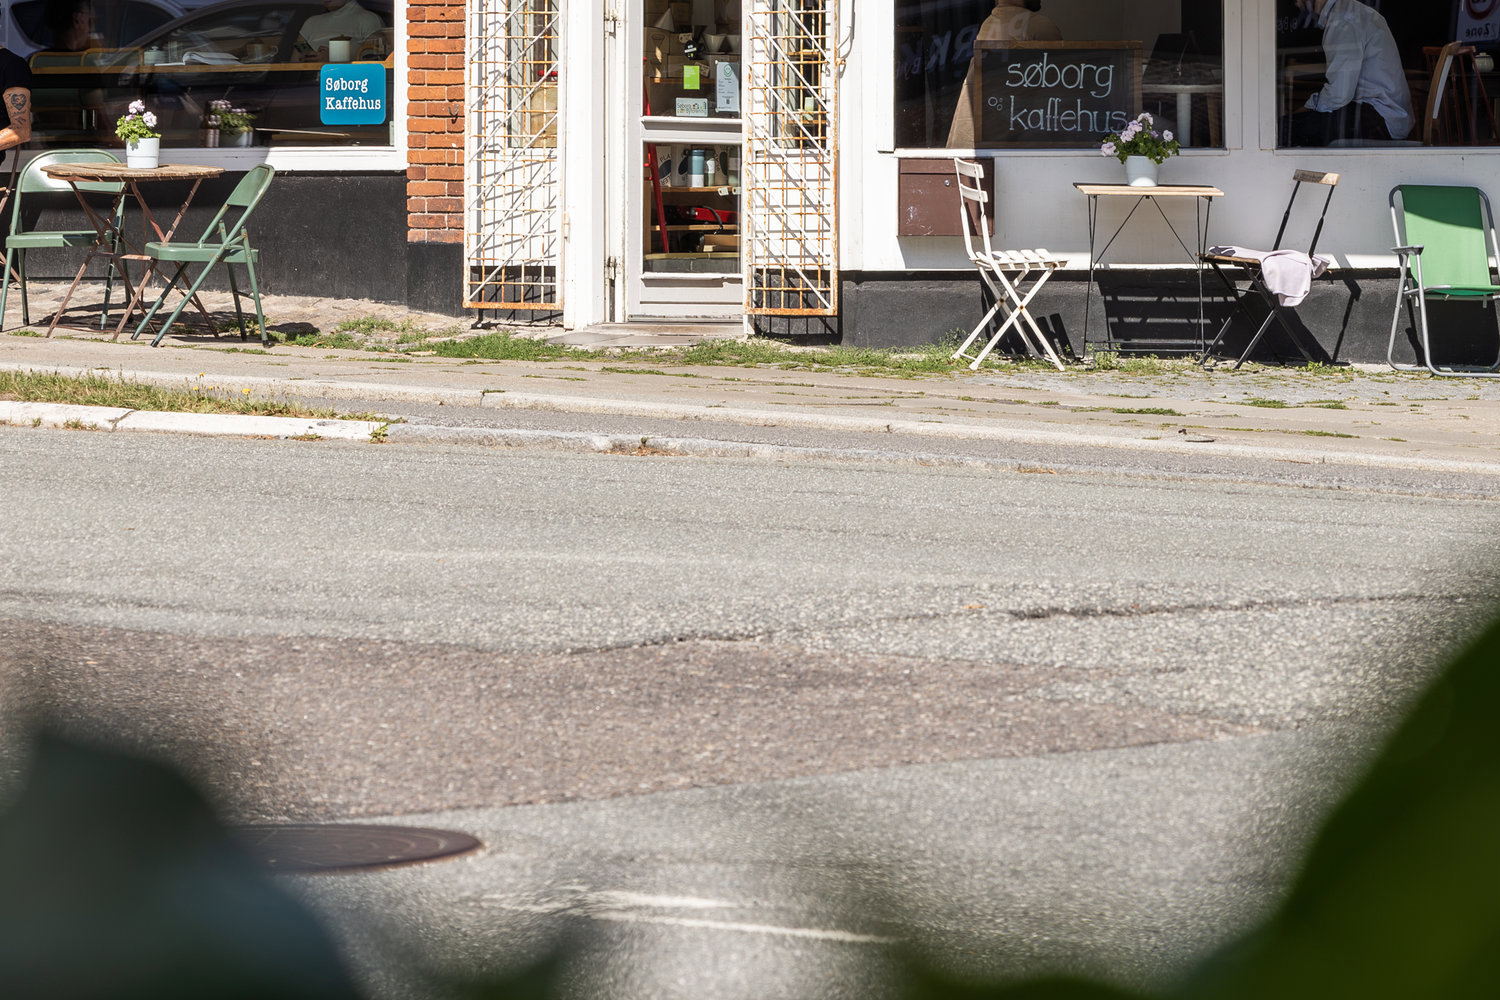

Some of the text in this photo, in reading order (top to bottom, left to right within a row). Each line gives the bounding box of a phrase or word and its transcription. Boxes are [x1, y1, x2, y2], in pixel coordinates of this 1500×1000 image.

[325, 77, 369, 94] Søborg
[1005, 52, 1117, 100] søborg
[325, 96, 382, 110] Kaffehus
[1009, 95, 1129, 133] kaffehus
